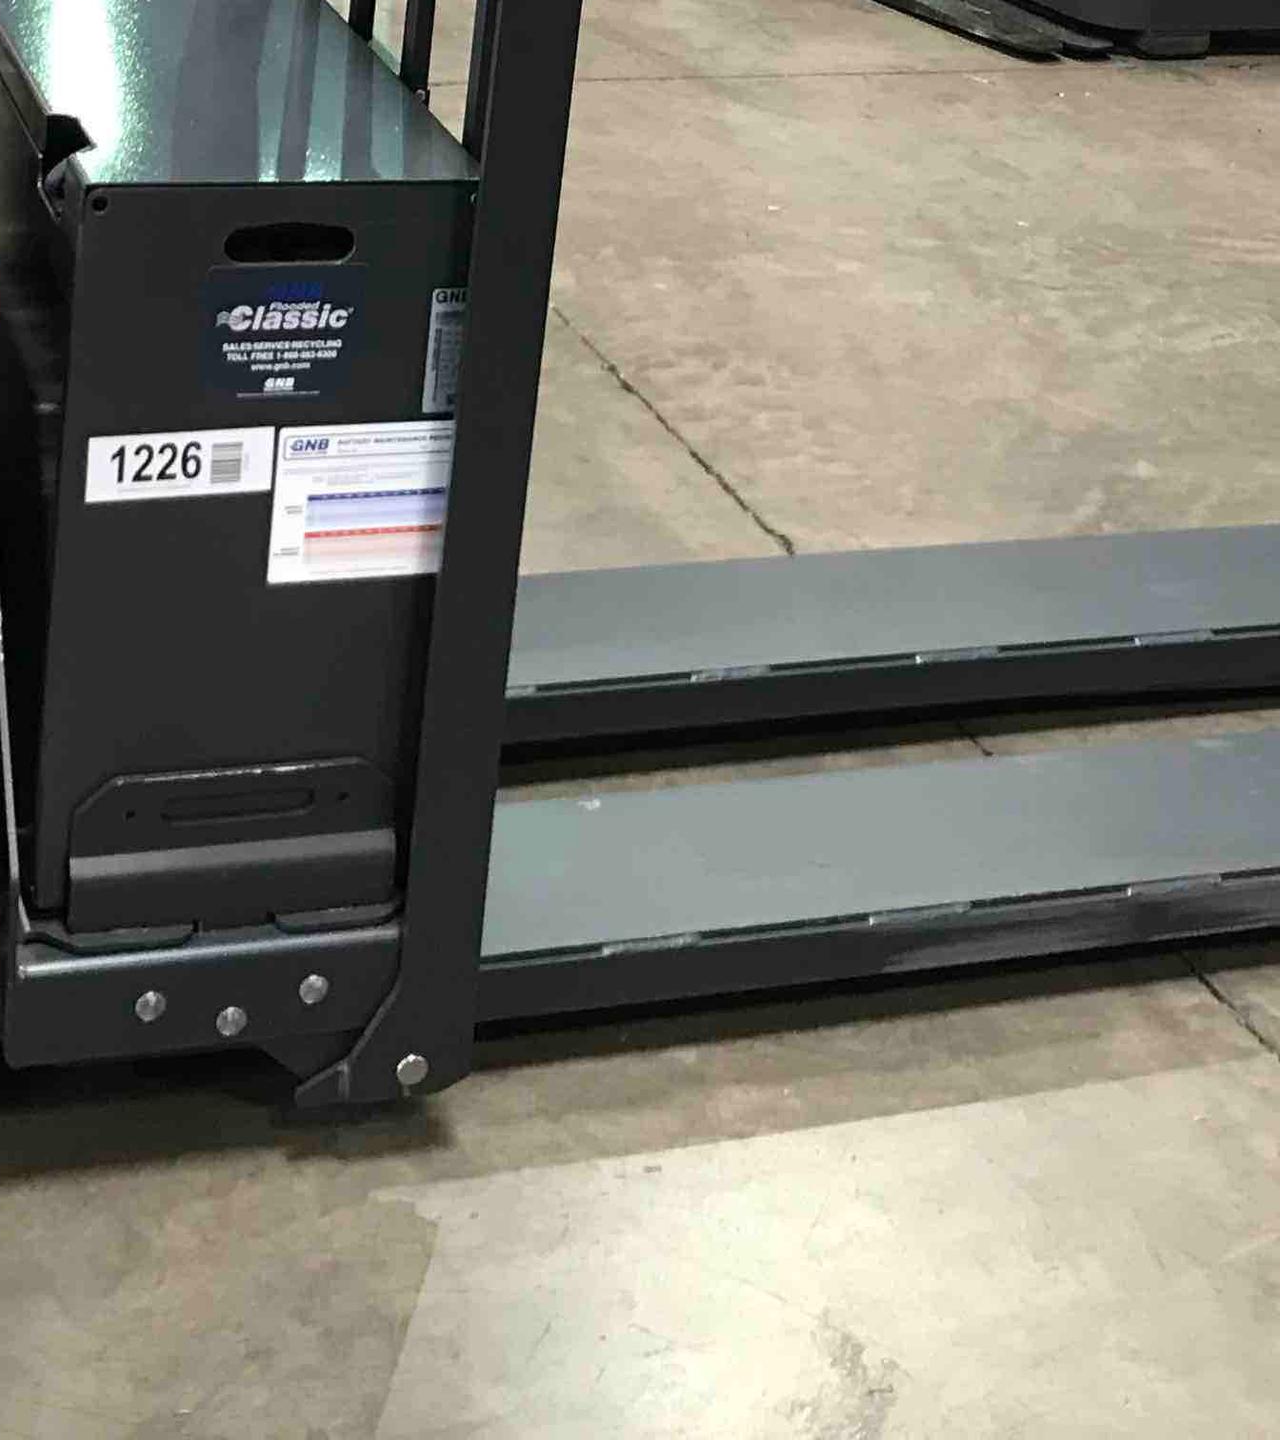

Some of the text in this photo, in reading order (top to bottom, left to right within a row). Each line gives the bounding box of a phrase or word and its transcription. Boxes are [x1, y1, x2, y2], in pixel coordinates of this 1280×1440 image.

[227, 304, 349, 333] Classic
[290, 437, 330, 453] GNB
[110, 441, 203, 484] 1226
